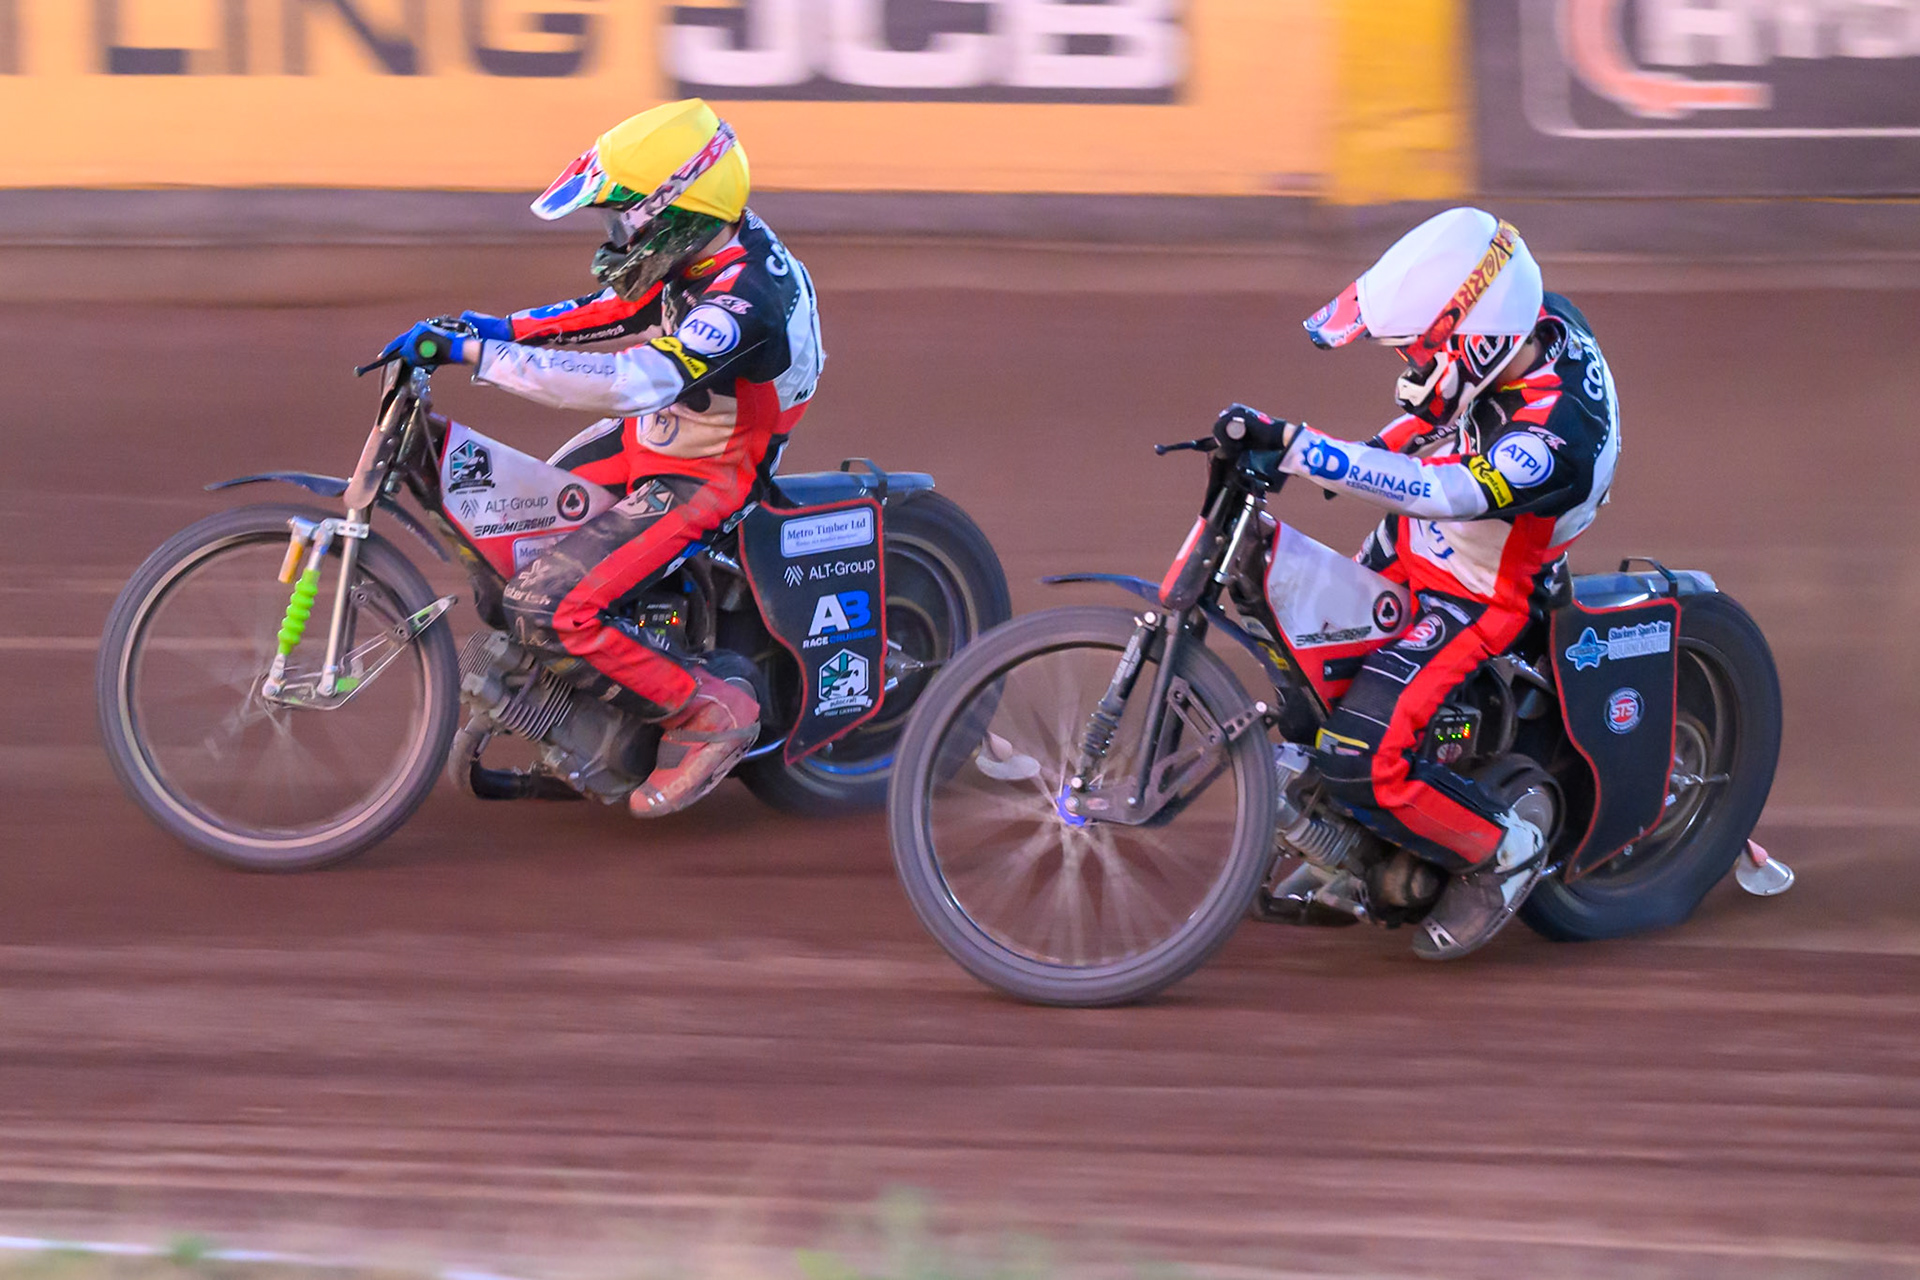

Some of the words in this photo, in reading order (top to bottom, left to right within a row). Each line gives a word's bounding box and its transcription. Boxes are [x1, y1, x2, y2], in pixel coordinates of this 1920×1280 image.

[684, 318, 727, 347] ATPI
[525, 354, 617, 378] ALT-Group
[1309, 439, 1432, 498] DRAINAGE
[1500, 443, 1542, 477] ATPI
[484, 496, 549, 514] ALT-Group
[479, 516, 556, 536] PREMIERSHIP
[786, 529, 814, 540] Metro
[815, 522, 849, 535] Timber
[850, 517, 866, 530] Ltd
[808, 558, 876, 581] ALT-Group
[808, 589, 872, 637] AB
[802, 636, 829, 649] RACE
[1610, 701, 1636, 718] STS
